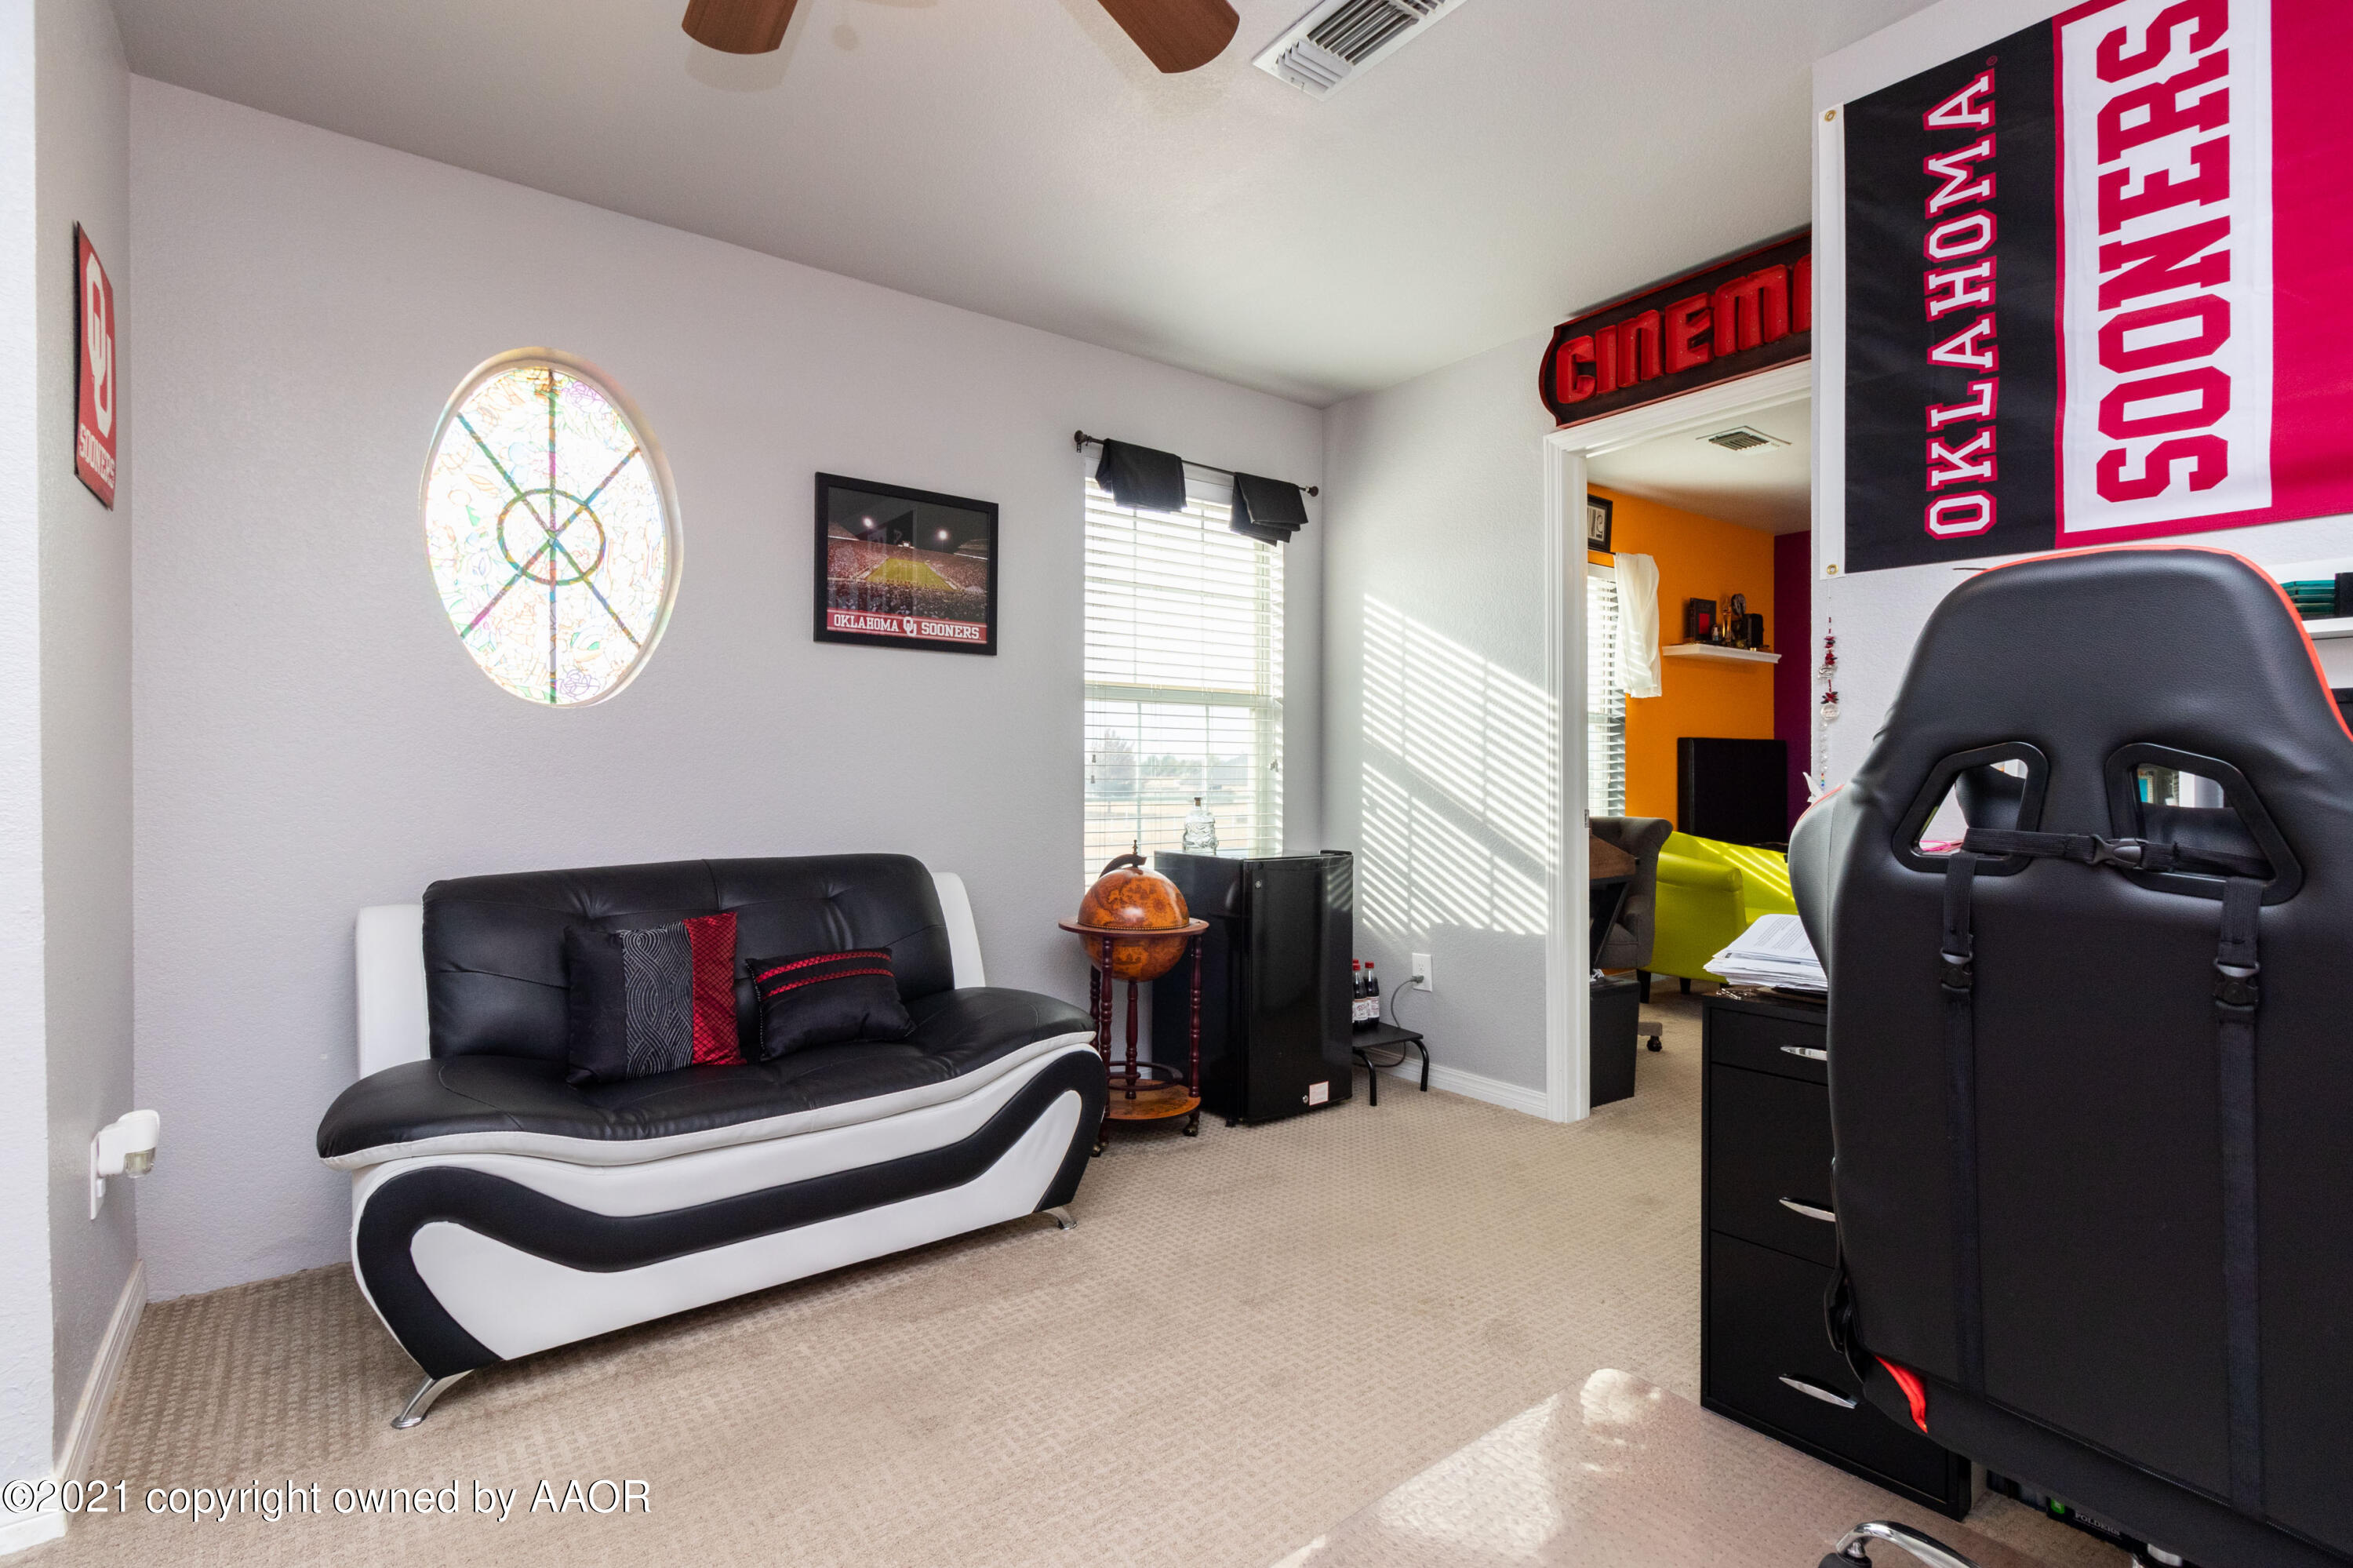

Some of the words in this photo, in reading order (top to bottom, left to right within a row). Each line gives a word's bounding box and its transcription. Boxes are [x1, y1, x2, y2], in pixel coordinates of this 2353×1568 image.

[1923, 68, 1998, 540] OKLAHOMA
[2097, 0, 2231, 503] SOONERS
[79, 422, 115, 489] SOONERS
[834, 614, 900, 632] OKLAHOMA
[921, 622, 980, 639] SOONERS
